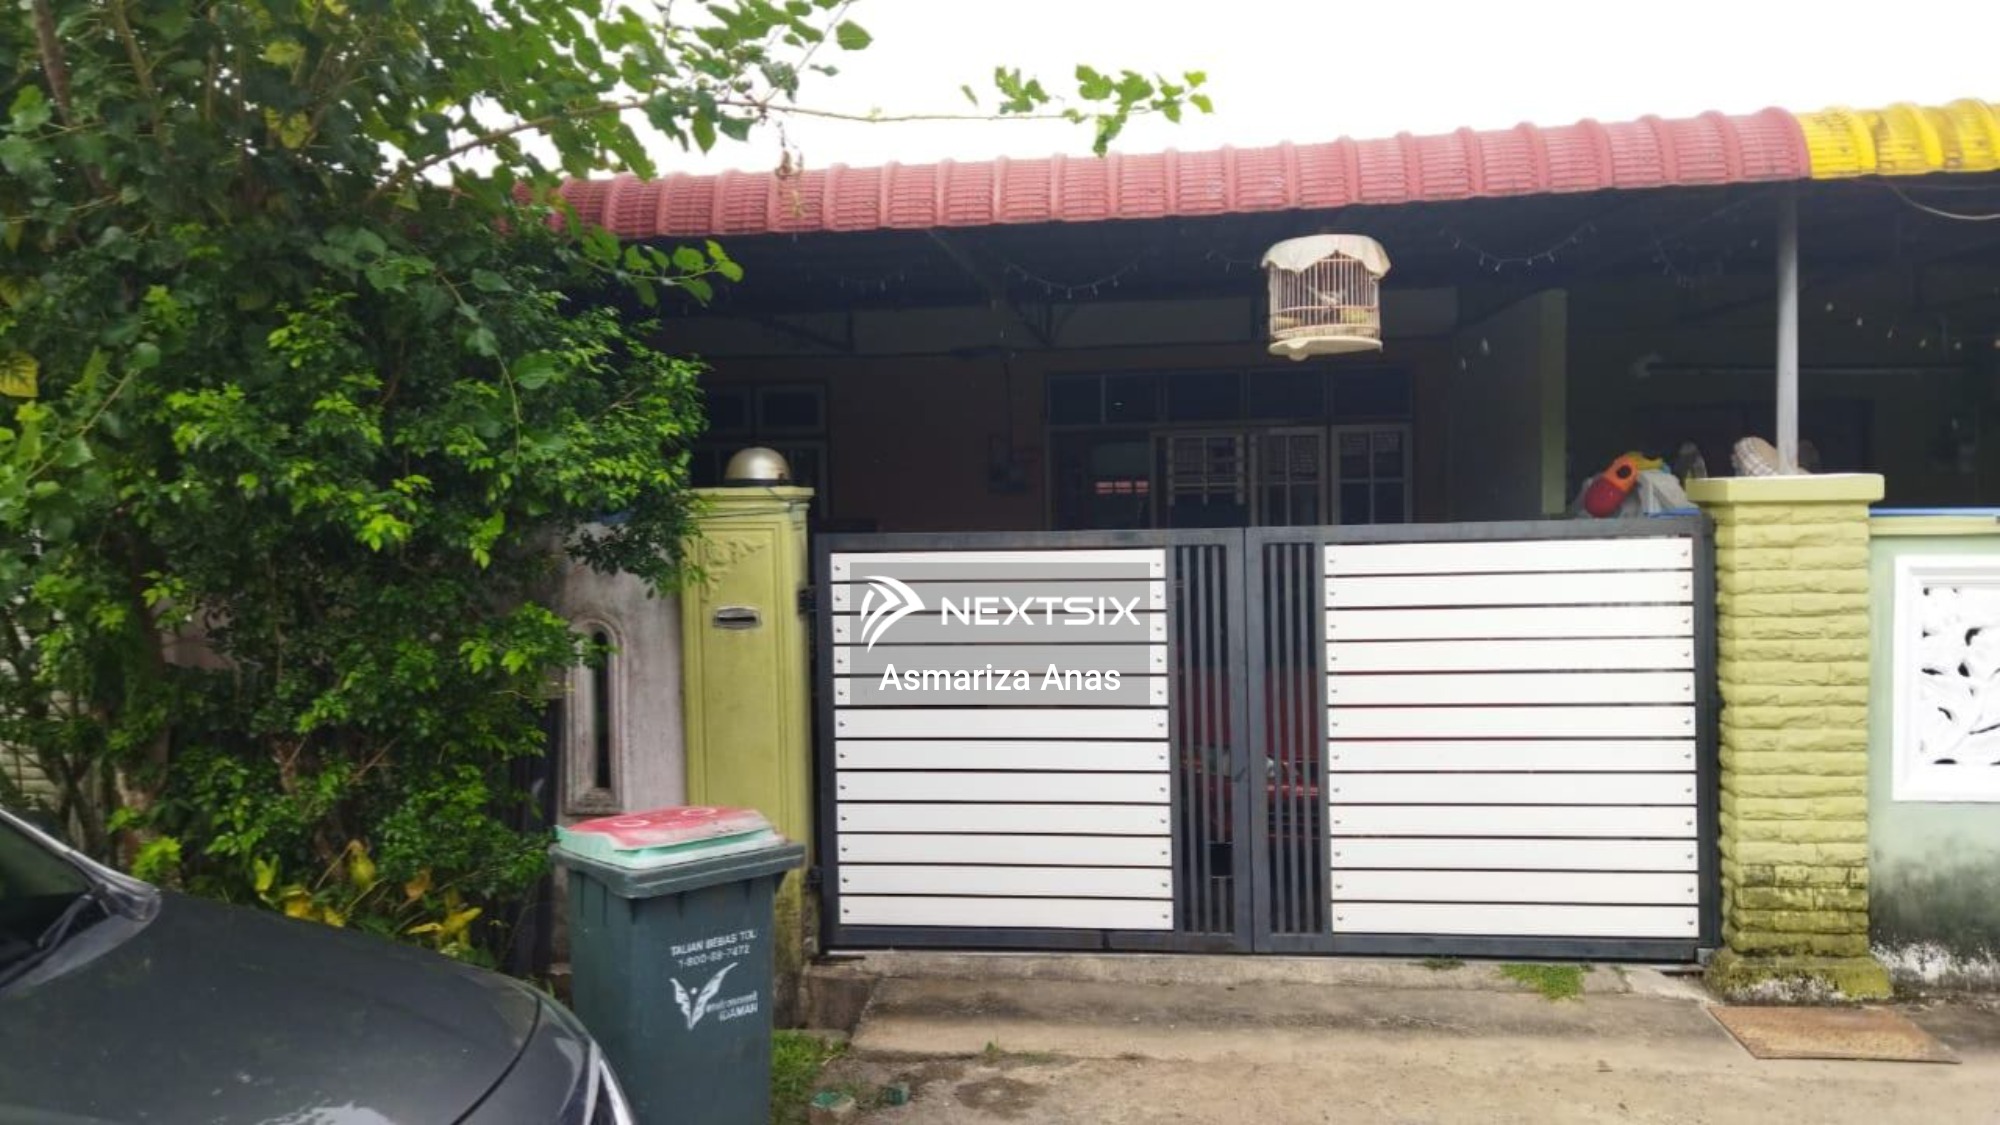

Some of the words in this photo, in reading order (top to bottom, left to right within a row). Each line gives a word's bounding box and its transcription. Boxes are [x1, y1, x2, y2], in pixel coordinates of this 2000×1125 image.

[670, 941, 703, 957] TALIAN
[706, 934, 738, 949] BEBAS
[740, 930, 757, 940] TOL
